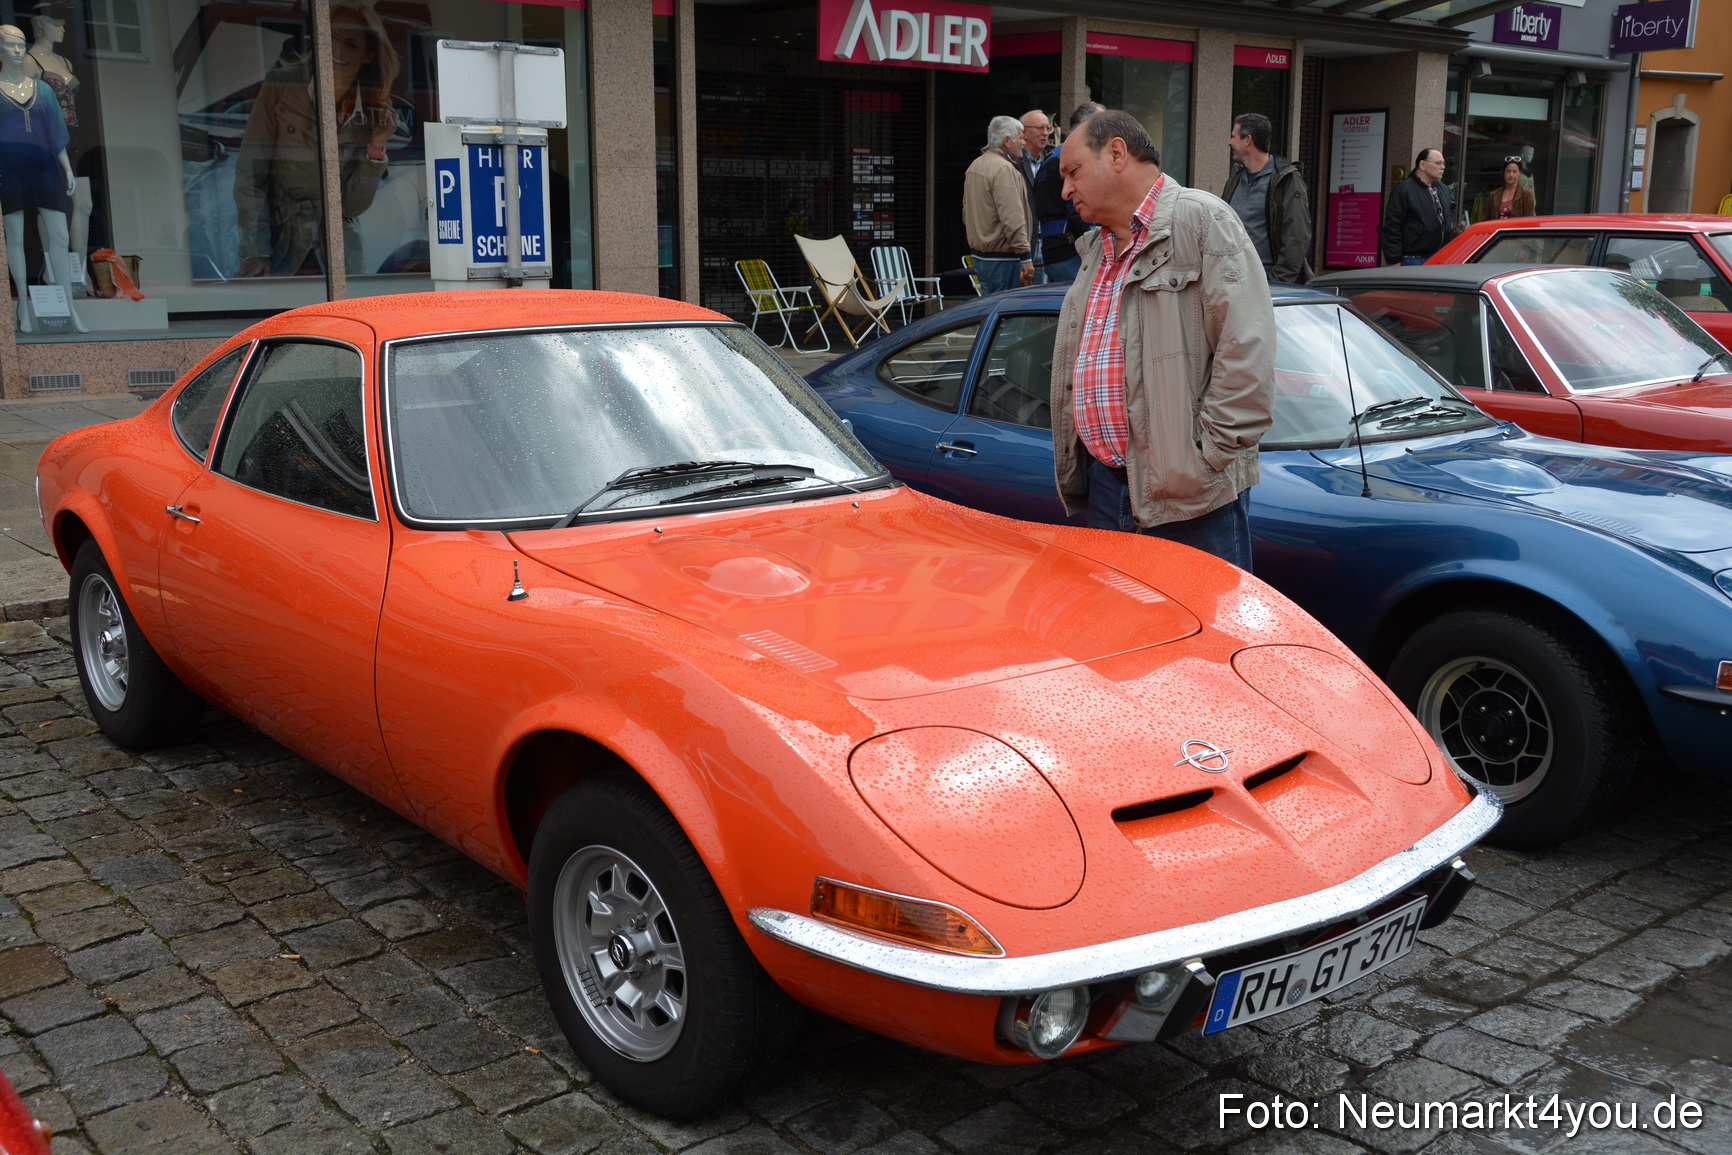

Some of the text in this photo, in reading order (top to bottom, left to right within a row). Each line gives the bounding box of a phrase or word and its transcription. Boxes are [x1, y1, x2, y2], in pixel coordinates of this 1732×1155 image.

[834, 0, 990, 67] ADLER
[1512, 5, 1552, 41] liberty
[1619, 15, 1685, 39] liberty
[1265, 52, 1287, 65] ADLER
[1342, 126, 1369, 134] VORTEILE
[1343, 116, 1370, 126] ADLER
[478, 147, 534, 169] HIR
[439, 170, 455, 208] P
[439, 219, 461, 240] SCHEINE
[477, 235, 541, 257] SCHNE
[1354, 254, 1375, 263] ADLER
[1232, 906, 1424, 1020] RH GT 37H
[1213, 1008, 1225, 1023] D
